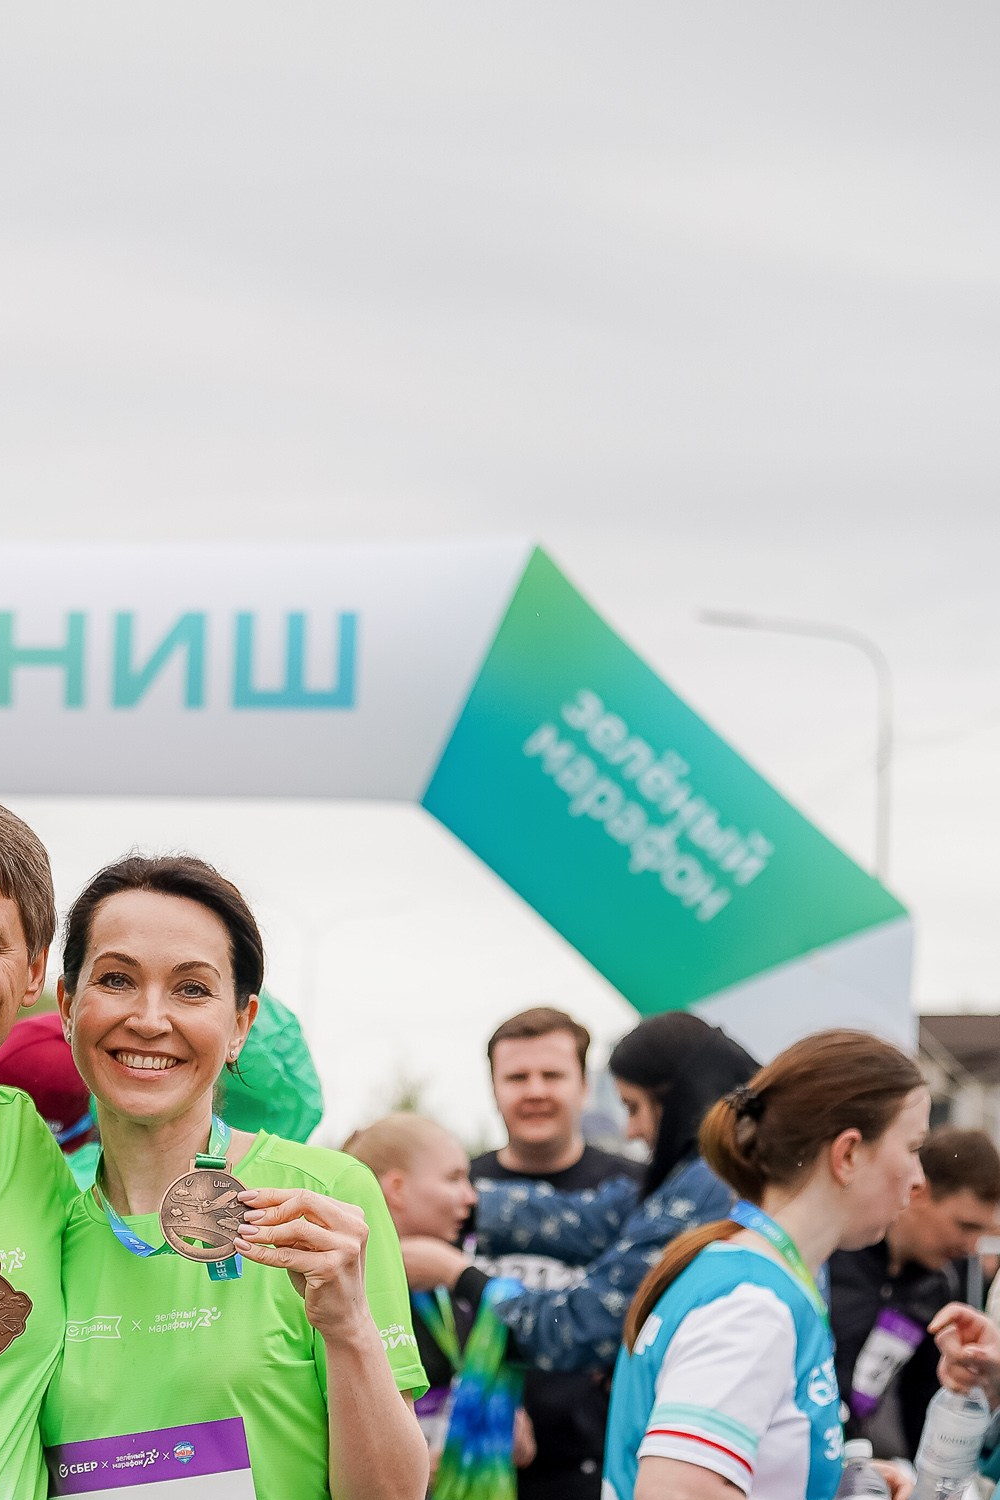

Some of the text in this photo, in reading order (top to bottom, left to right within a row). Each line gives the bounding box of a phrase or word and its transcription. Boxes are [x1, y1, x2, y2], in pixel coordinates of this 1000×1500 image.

[561, 688, 775, 887] зелёный
[522, 723, 731, 922] марафон
[154, 1307, 197, 1322] зелёный
[81, 1322, 112, 1335] Прайм
[148, 1319, 193, 1334] марафон
[115, 1450, 146, 1462] зелёный
[69, 1461, 98, 1475] СБЕР
[112, 1460, 143, 1470] марафон
